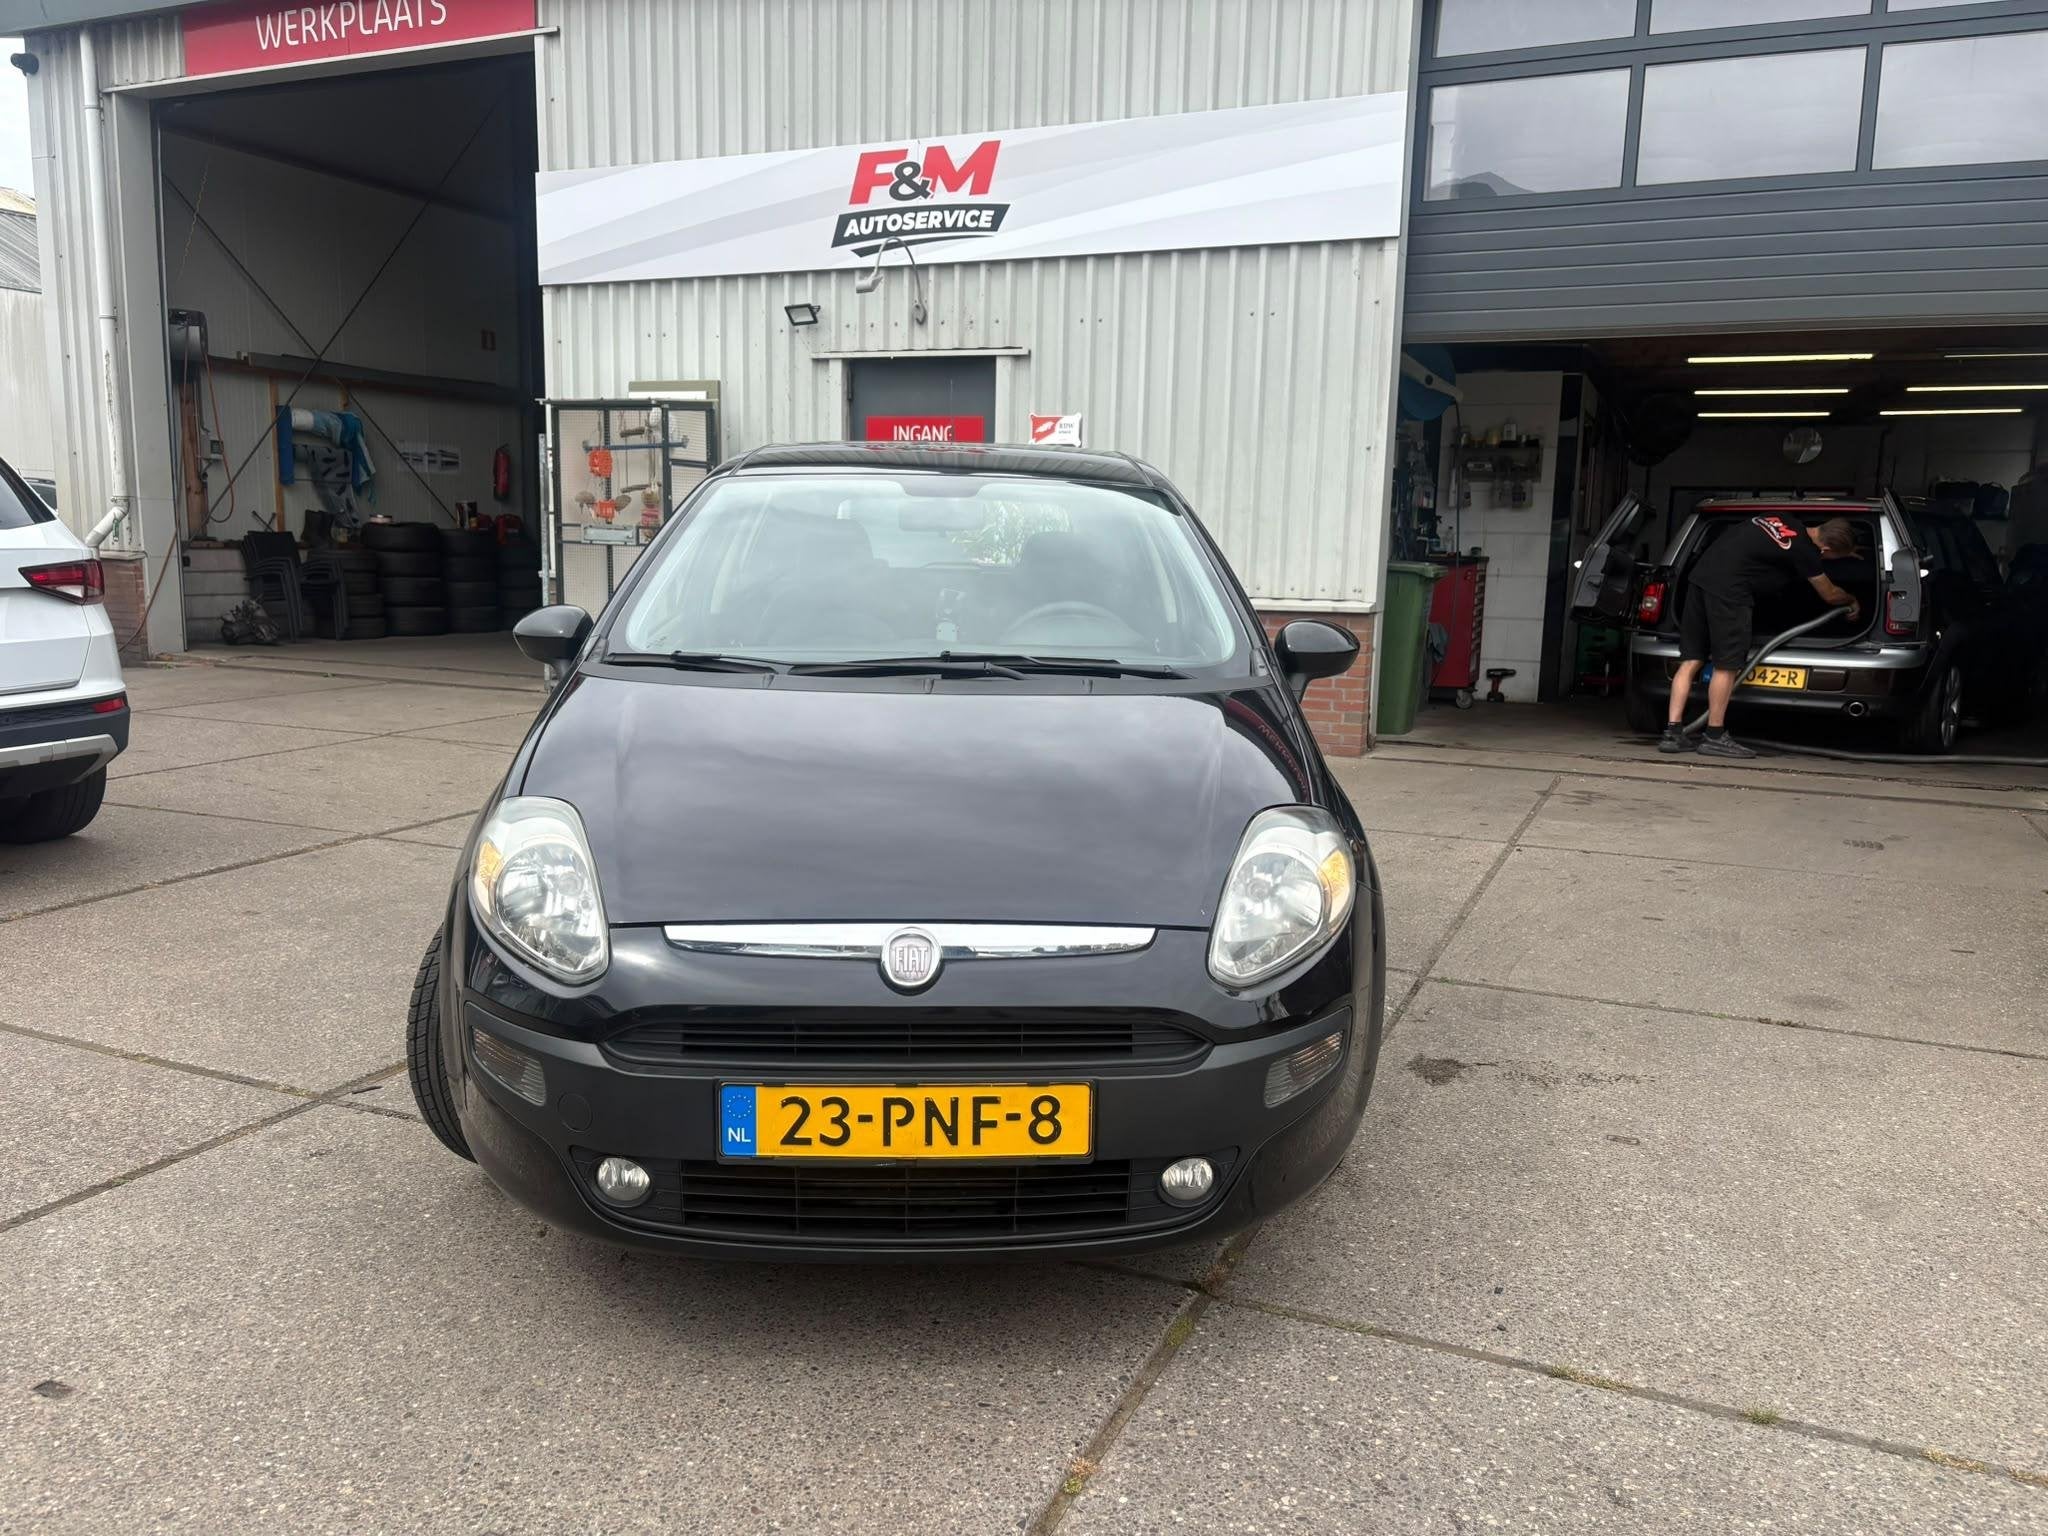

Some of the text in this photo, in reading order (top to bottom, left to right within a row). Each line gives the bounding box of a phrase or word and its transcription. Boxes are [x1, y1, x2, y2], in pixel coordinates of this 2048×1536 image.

[255, 0, 447, 50] WERKPLAATS
[849, 140, 1001, 205] F&M
[843, 210, 995, 238] AUTOSERVICE
[1745, 669, 1798, 685] 042-R
[895, 946, 929, 972] FIAT
[780, 1094, 1062, 1147] 23-PNF-8
[727, 1127, 752, 1143] NL
